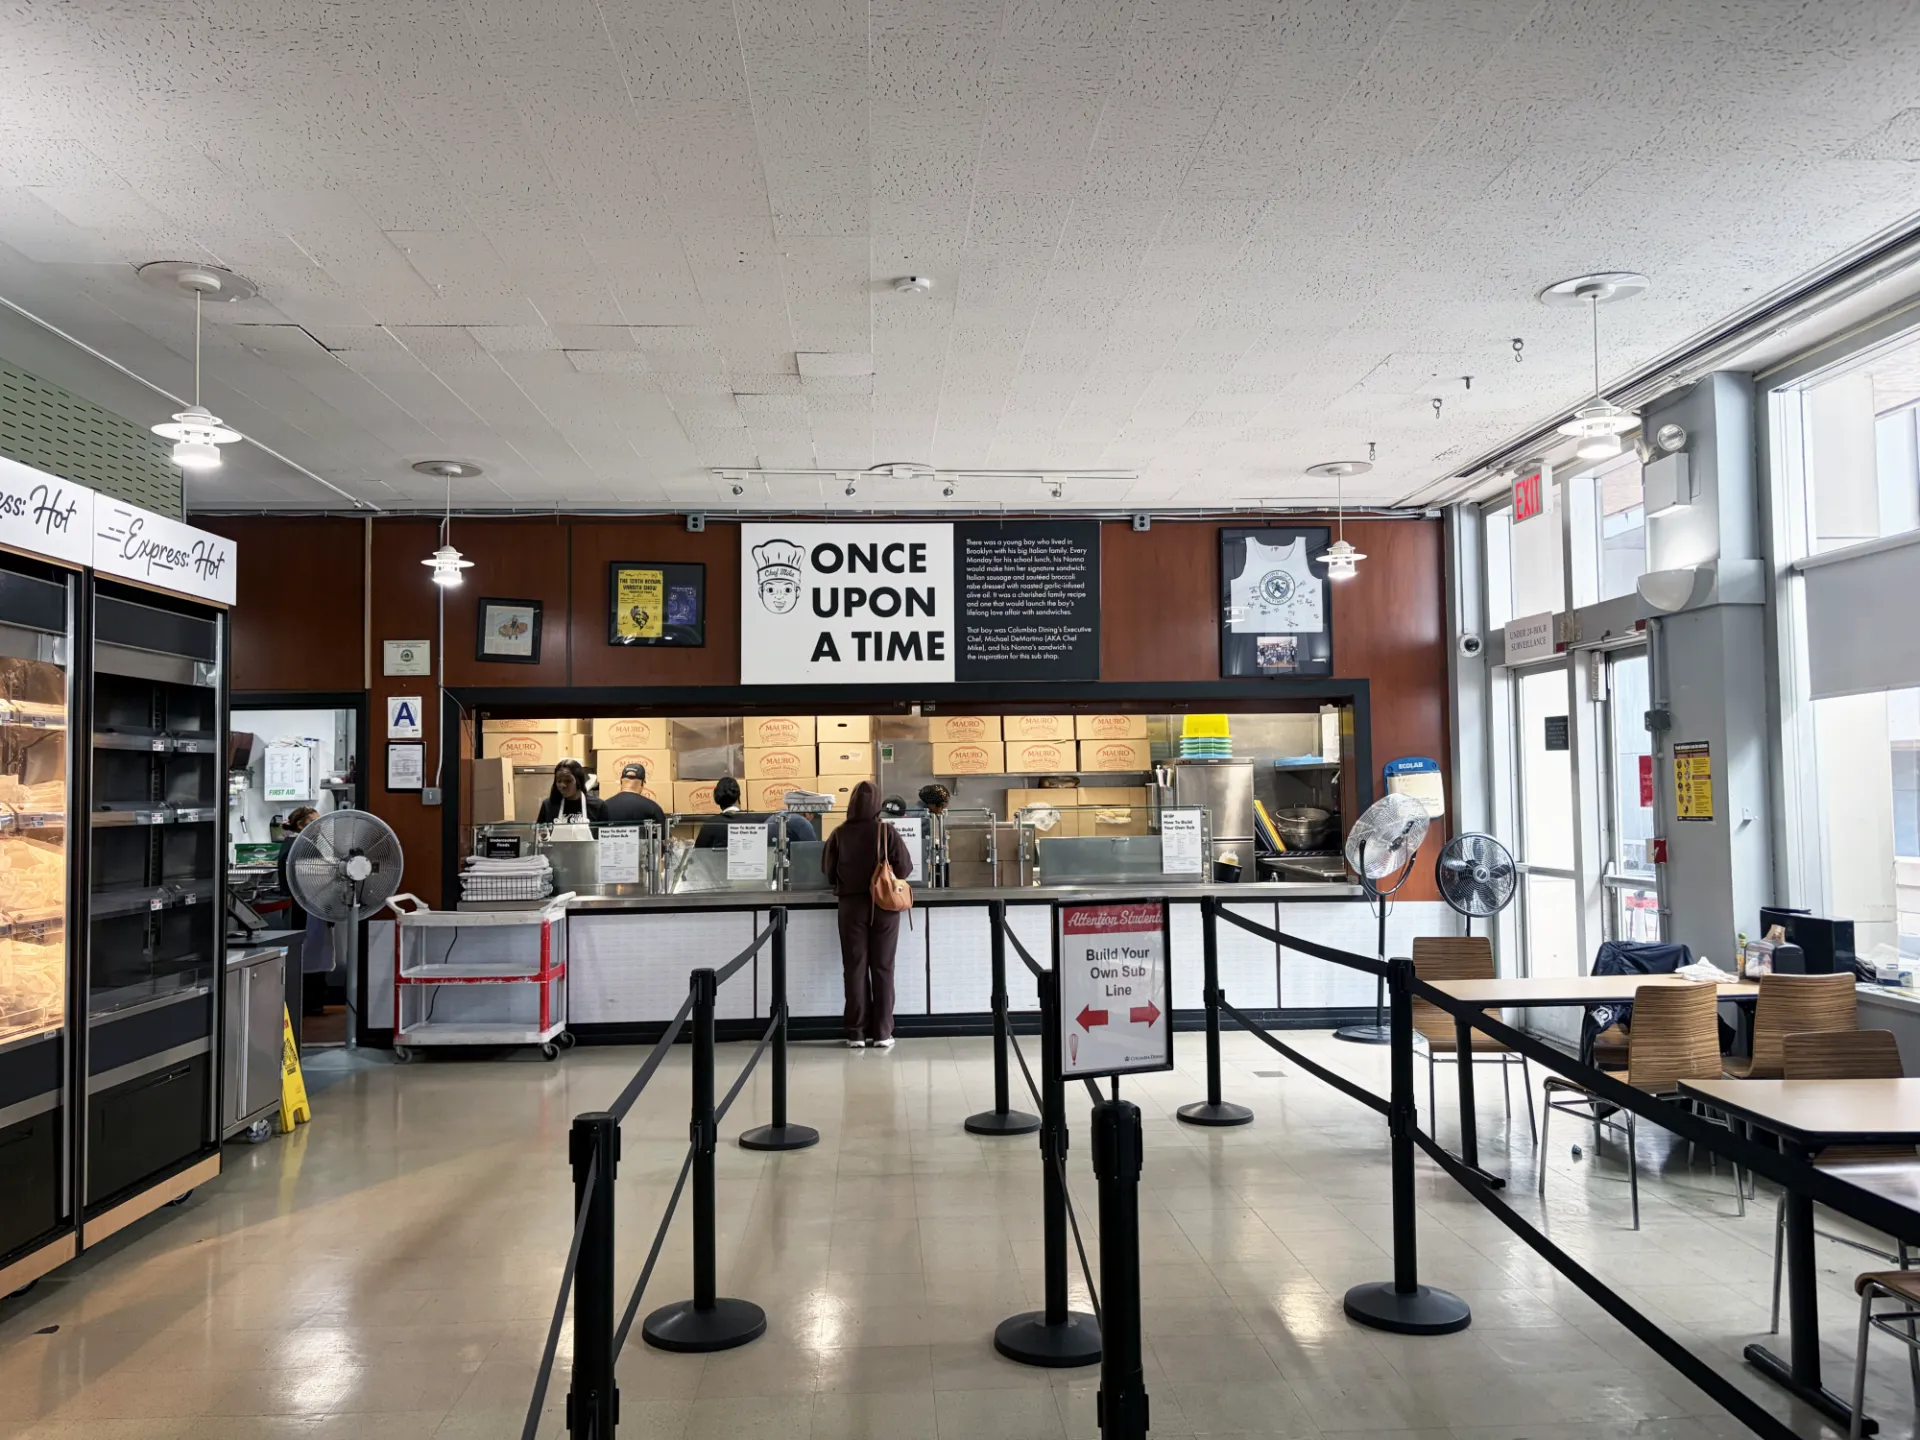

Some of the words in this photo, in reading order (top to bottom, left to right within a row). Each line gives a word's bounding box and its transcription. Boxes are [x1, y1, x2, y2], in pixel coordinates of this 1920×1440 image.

[1515, 473, 1541, 520] EXIT
[30, 484, 76, 535] Hot
[1023, 538, 1035, 546] boy
[124, 518, 190, 576] Express:
[192, 540, 226, 581] Hot
[966, 547, 992, 556] Brooklyn
[1017, 547, 1027, 556] big
[1069, 546, 1087, 555] Every
[810, 542, 926, 574] ONCE
[966, 556, 992, 565] Monday
[765, 568, 779, 577] Chef
[1027, 564, 1054, 573] signature
[1047, 590, 1066, 599] family
[1066, 590, 1086, 599] recipe
[812, 586, 936, 618] UPON
[966, 609, 989, 618] lifelong
[980, 626, 992, 635] boy
[1510, 629, 1526, 640] UNDER
[1527, 624, 1547, 636] 24-HOUR
[810, 632, 841, 662] A
[851, 630, 945, 662] TIME
[1511, 636, 1546, 651] SURVEILLANCE
[977, 652, 1008, 661] inspiration
[393, 702, 416, 726] A
[1068, 912, 1118, 928] Attention
[1086, 948, 1118, 961] Build
[1121, 947, 1150, 959] Your
[1090, 966, 1118, 979] Own
[1122, 965, 1146, 978] Sub
[1106, 984, 1132, 997] Line
